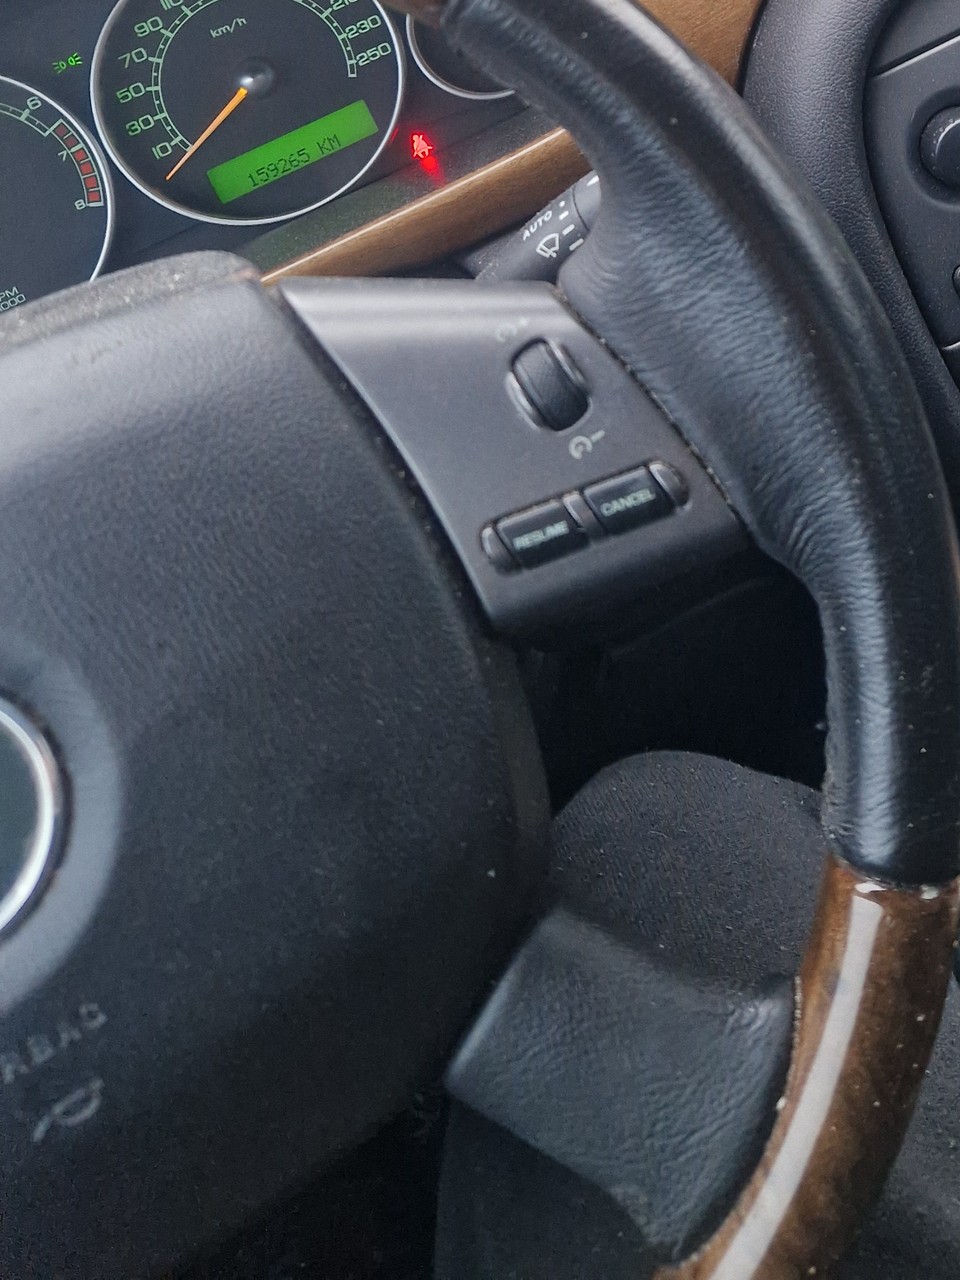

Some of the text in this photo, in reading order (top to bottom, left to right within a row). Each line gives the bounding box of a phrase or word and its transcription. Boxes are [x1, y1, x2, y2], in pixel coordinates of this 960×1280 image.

[133, 16, 163, 38] 90
[210, 16, 247, 39] km/h
[345, 14, 382, 38] 230
[118, 47, 148, 69] 70
[356, 42, 392, 66] 250
[26, 96, 42, 111] 6
[116, 82, 146, 104] 50
[125, 114, 155, 137] 30
[57, 150, 69, 162] 7
[151, 142, 173, 160] 10
[248, 134, 342, 187] 159265 KM
[74, 199, 86, 211] 8
[522, 210, 553, 242] AUTO
[601, 487, 655, 517] CANCEL
[512, 520, 570, 551] RESUME
